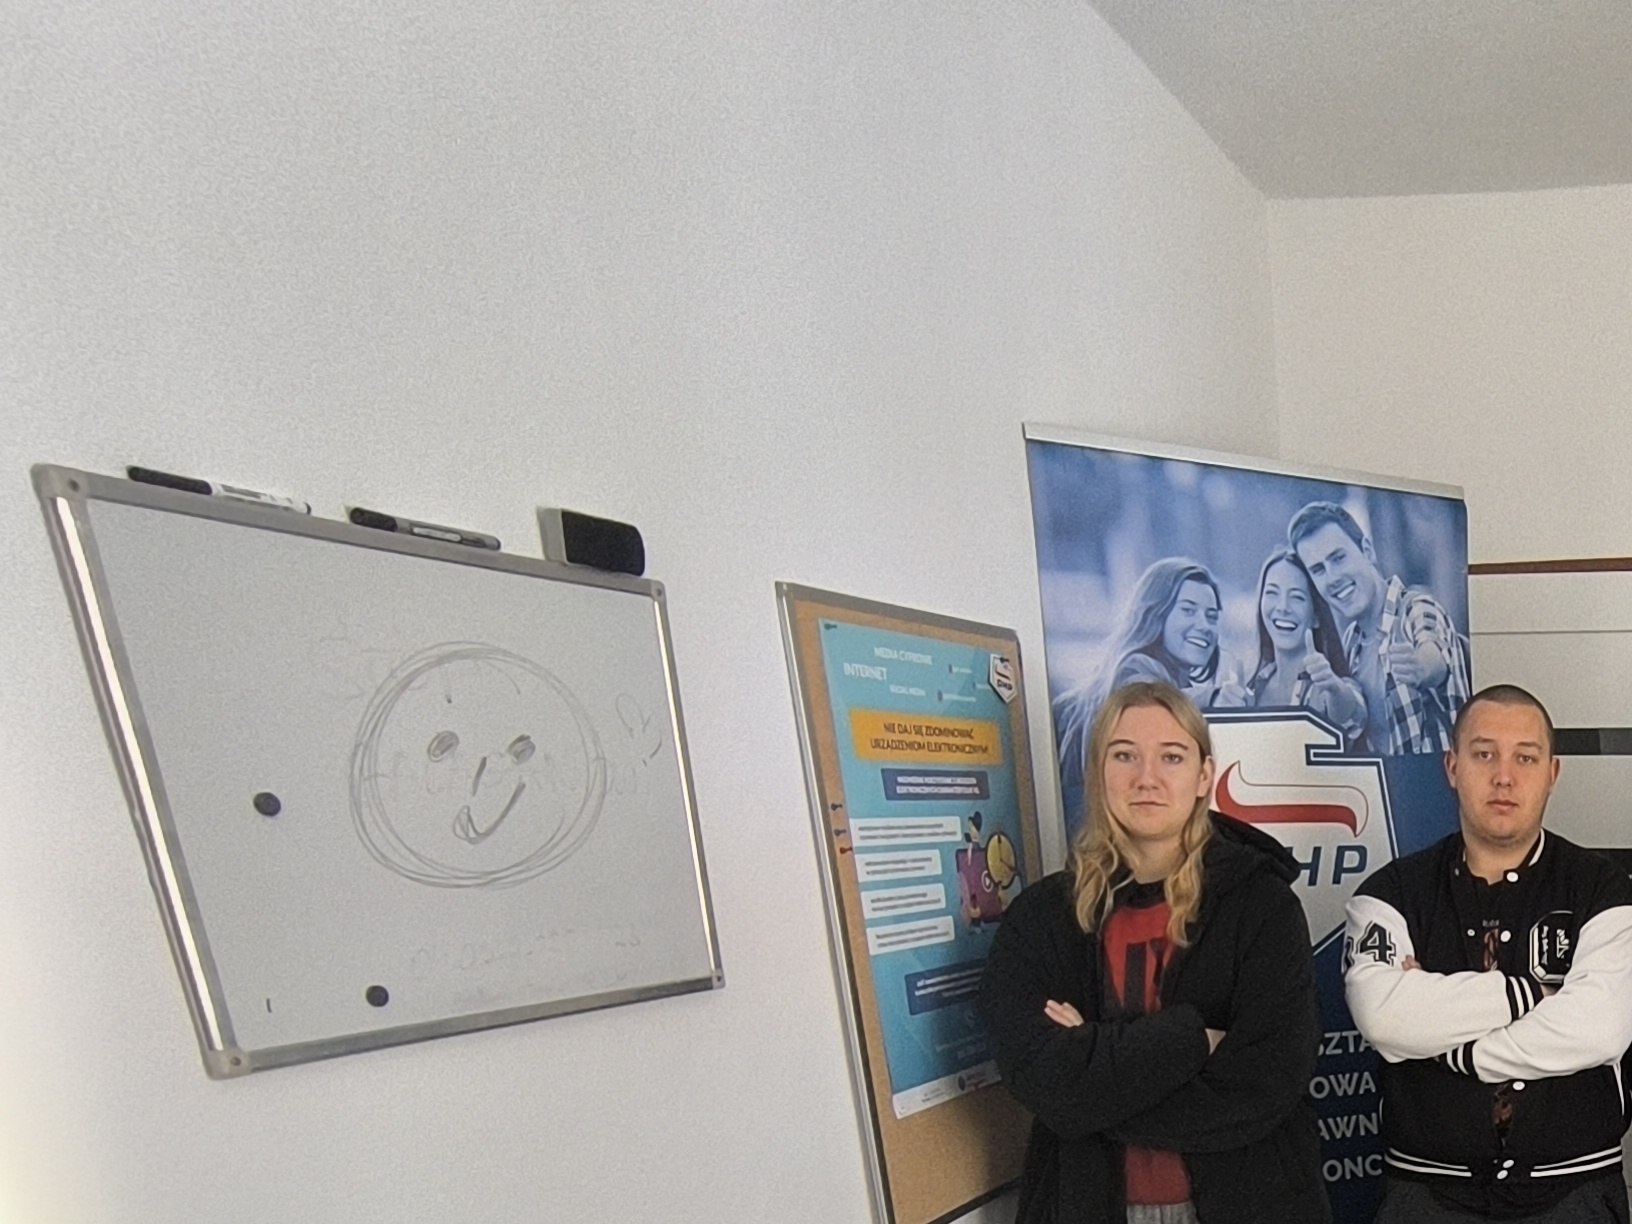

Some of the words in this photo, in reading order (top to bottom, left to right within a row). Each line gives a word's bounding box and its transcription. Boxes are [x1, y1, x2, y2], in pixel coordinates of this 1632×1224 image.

[843, 662, 887, 681] INTERNET
[883, 722, 896, 734] NIE
[897, 724, 912, 735] DAJ
[1322, 1154, 1383, 1182] ONC
